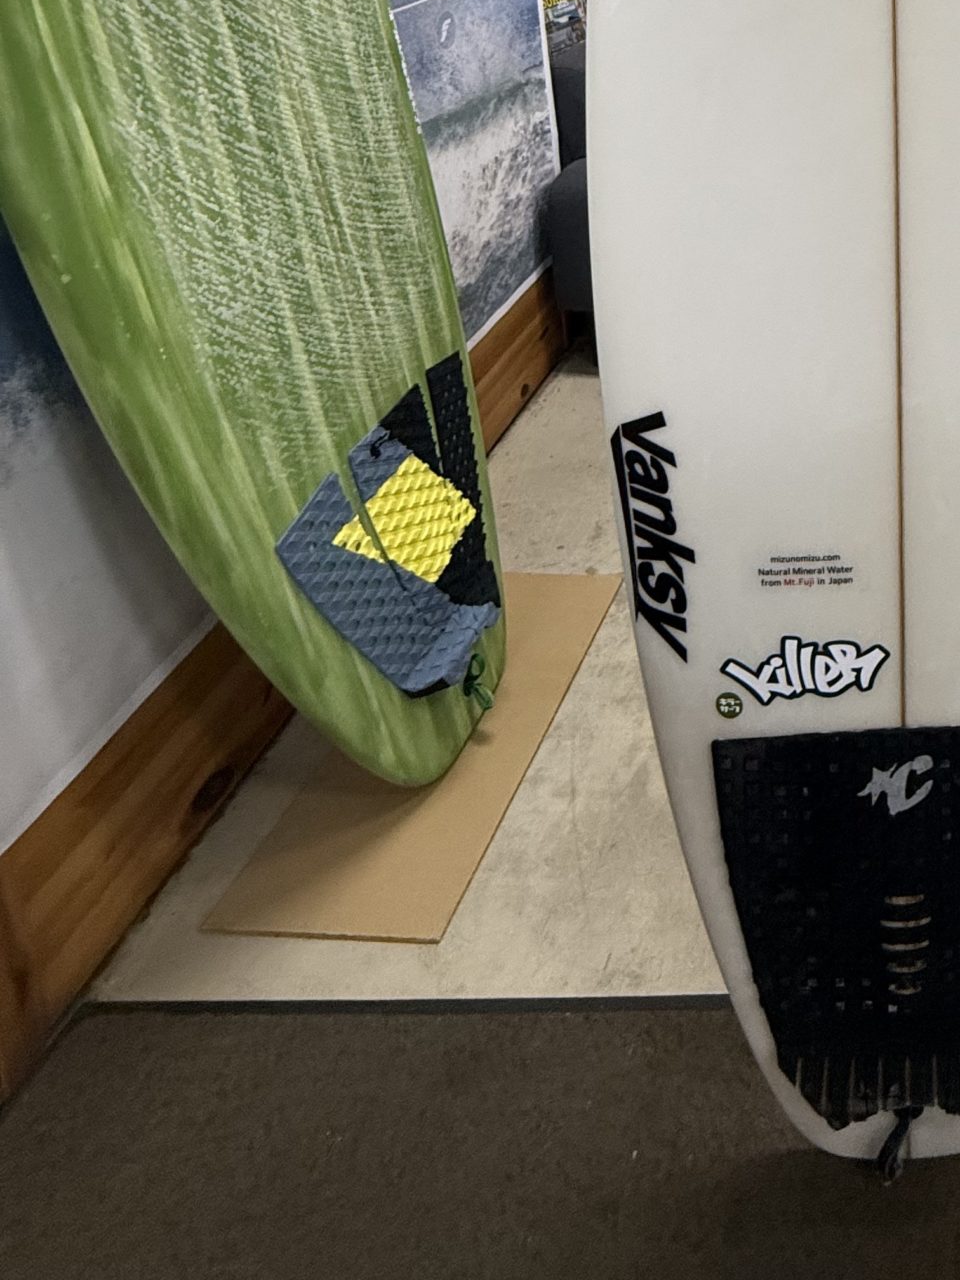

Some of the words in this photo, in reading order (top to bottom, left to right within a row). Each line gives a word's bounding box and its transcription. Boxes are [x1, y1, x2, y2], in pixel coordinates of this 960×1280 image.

[769, 554, 841, 563] mizunomizu.com
[757, 567, 791, 577] Natural
[792, 566, 825, 575] Mineral
[827, 565, 854, 574] Water
[761, 578, 782, 587] from
[817, 577, 825, 585] in
[828, 576, 854, 586] Japan
